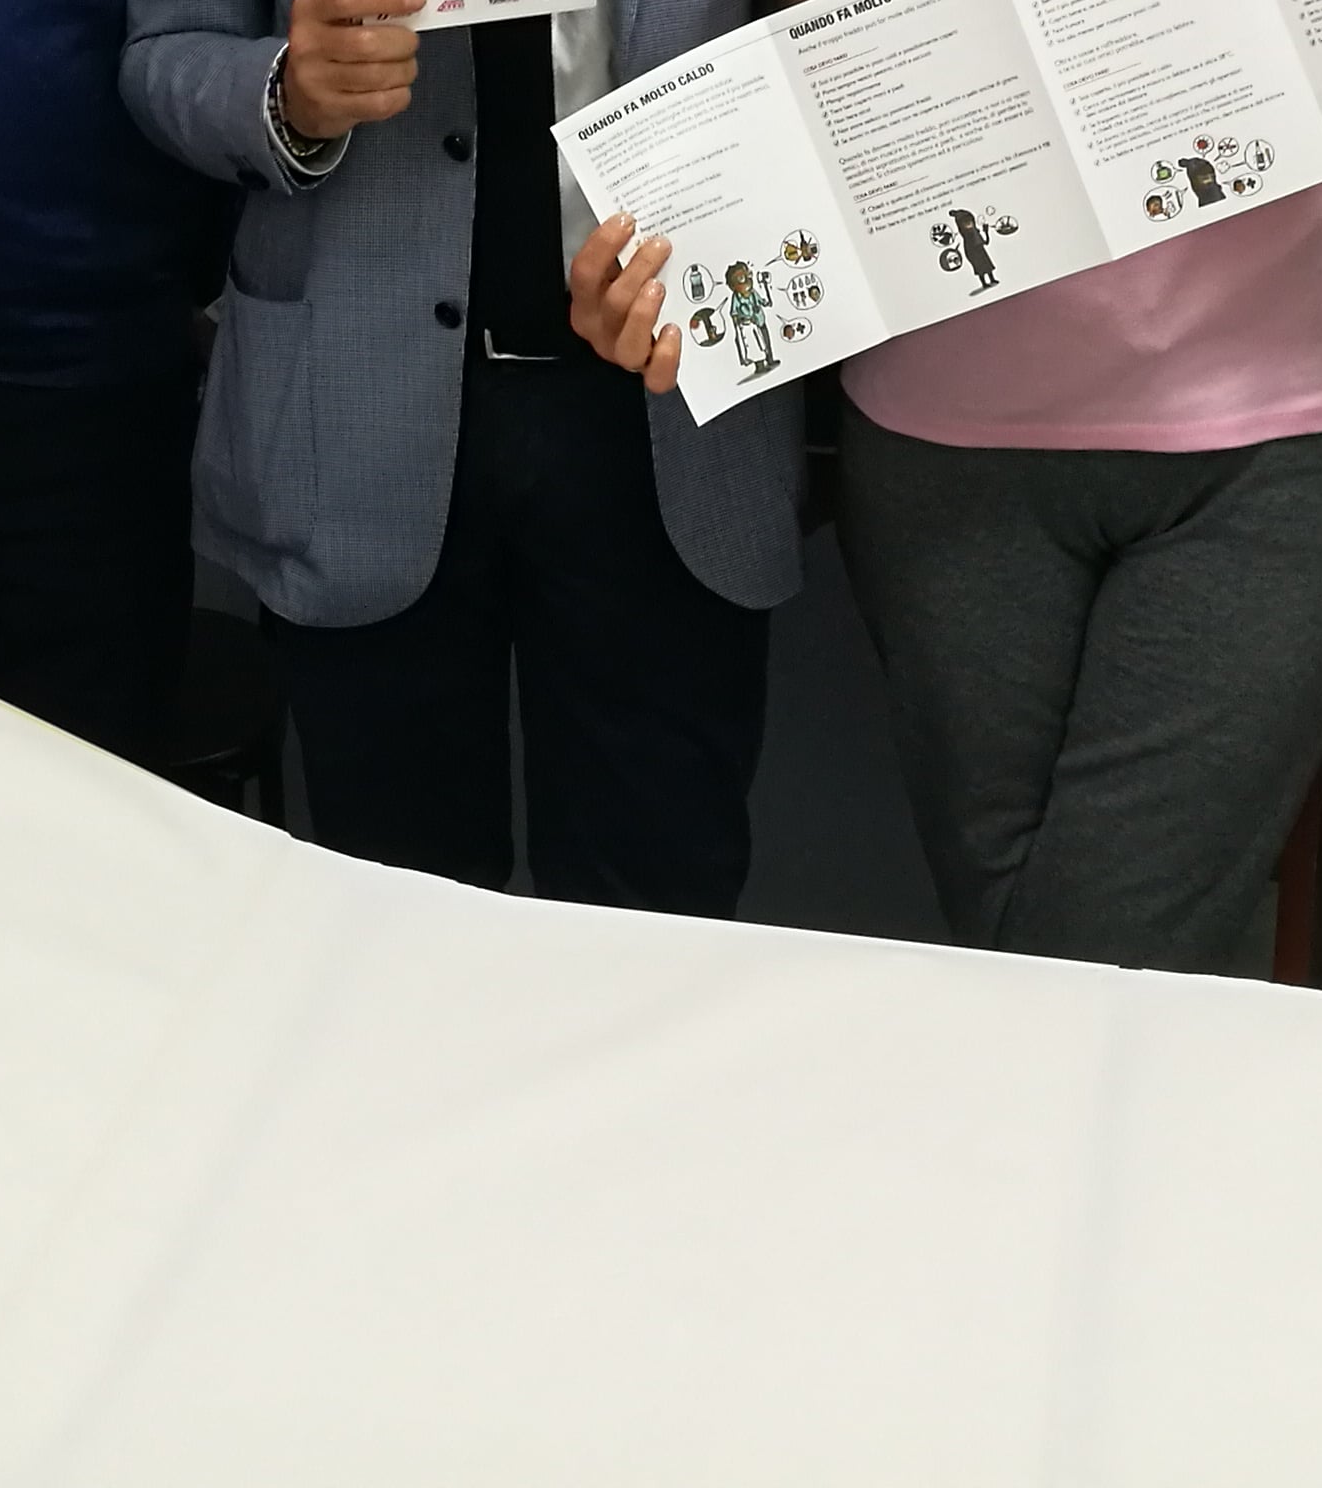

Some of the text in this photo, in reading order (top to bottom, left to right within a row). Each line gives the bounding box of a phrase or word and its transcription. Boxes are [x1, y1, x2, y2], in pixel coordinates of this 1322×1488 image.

[789, 14, 835, 39] QUANDO
[836, 7, 852, 21] FA
[578, 111, 622, 140] QUANDO
[624, 102, 639, 114] FA
[639, 81, 676, 106] MOLTO
[678, 63, 714, 86] CALDO
